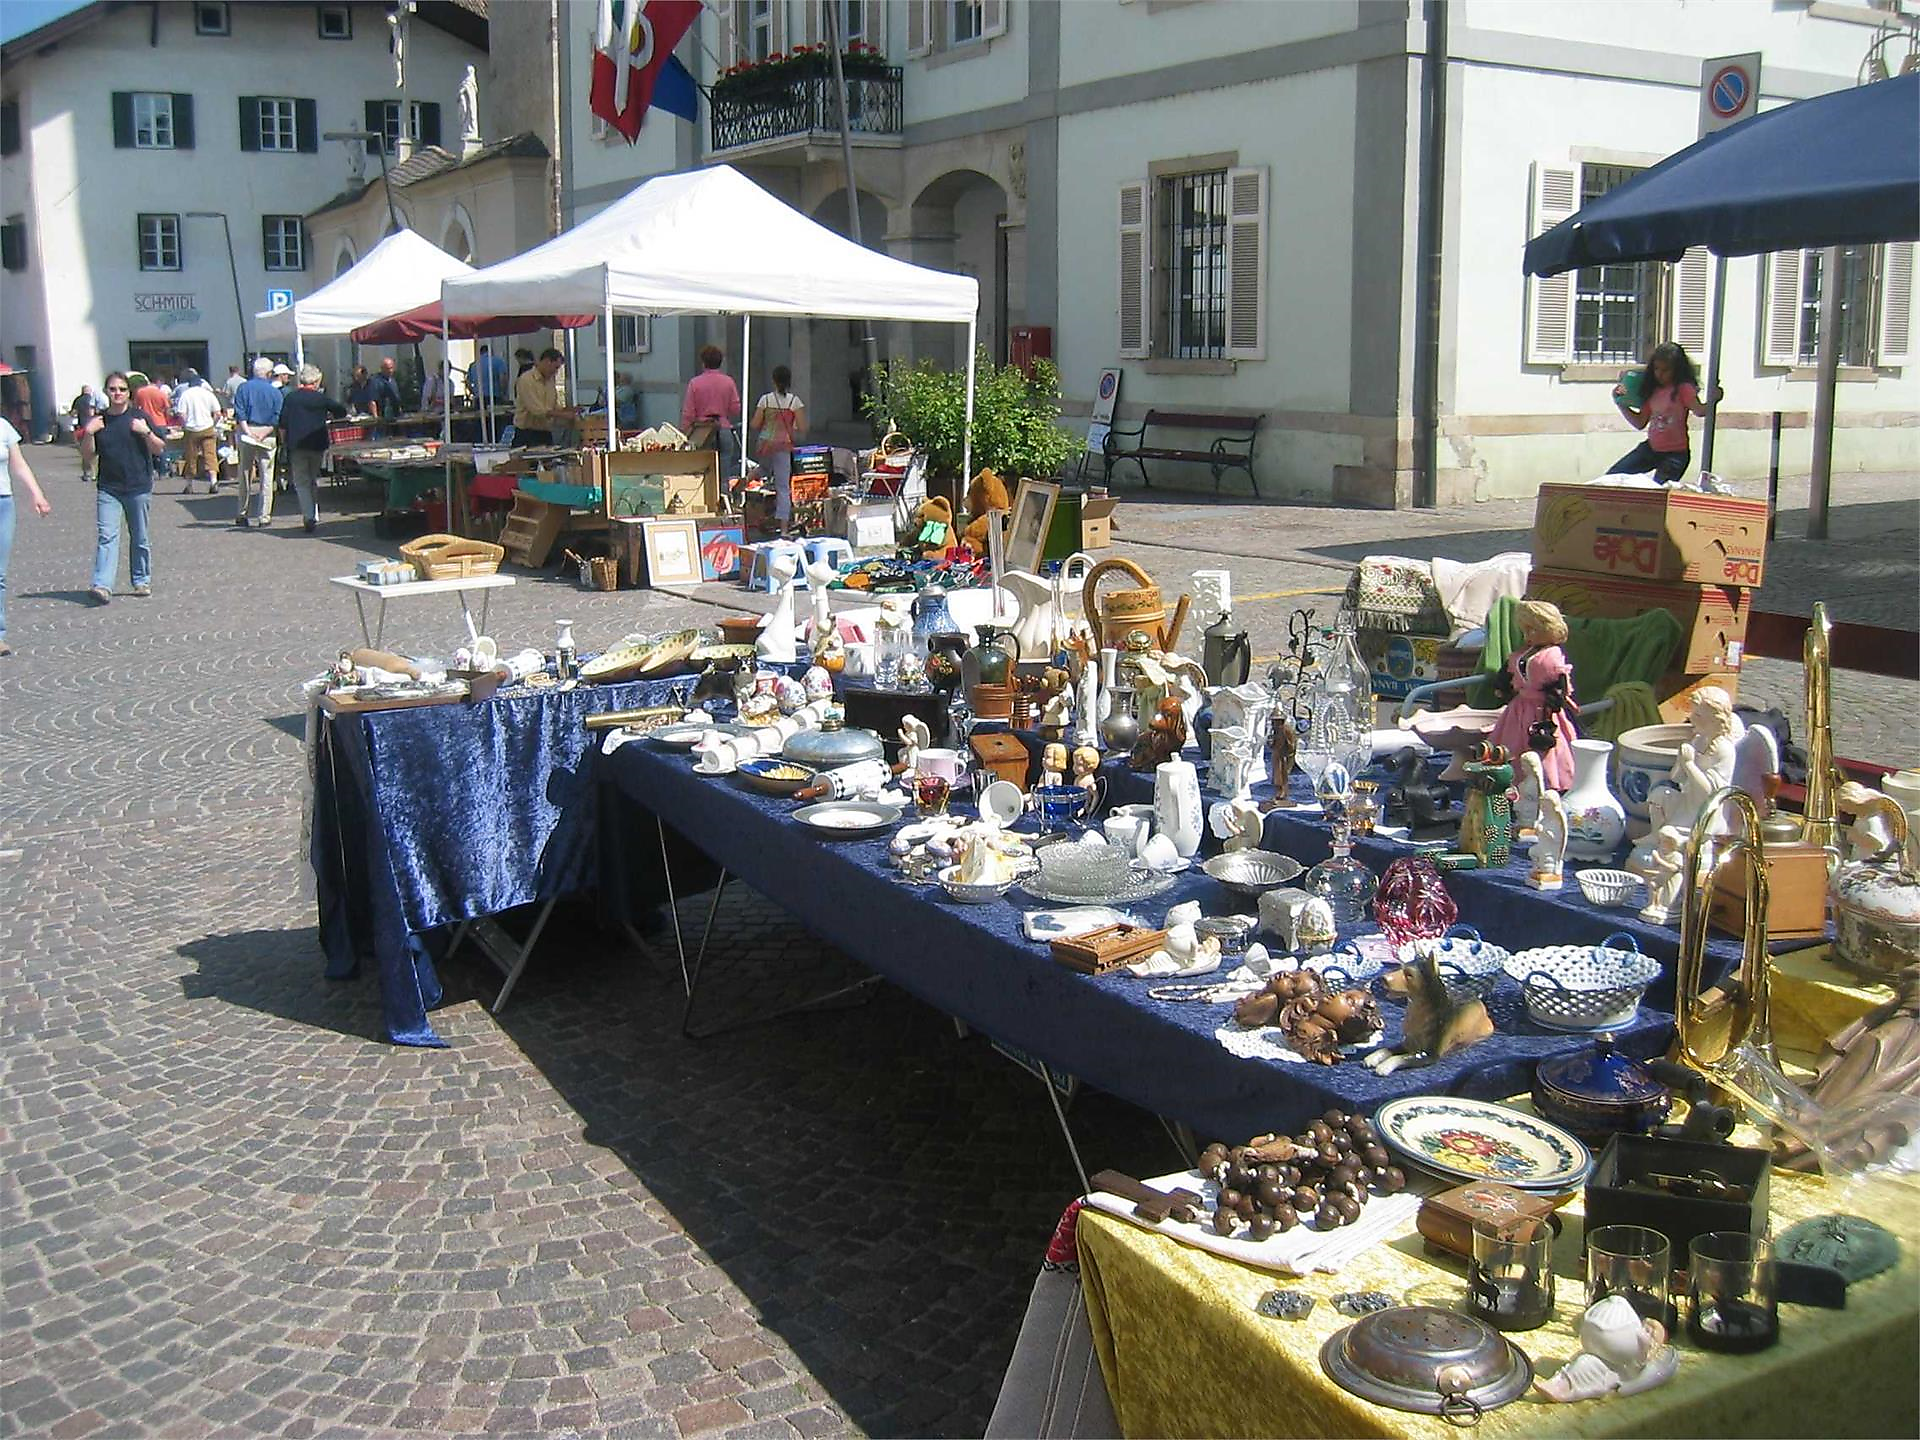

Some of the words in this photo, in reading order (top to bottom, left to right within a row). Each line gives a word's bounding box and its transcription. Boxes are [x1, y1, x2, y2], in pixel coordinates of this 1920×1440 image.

[272, 292, 288, 311] P
[1593, 535, 1659, 574] Dole
[1723, 560, 1760, 584] Dole
